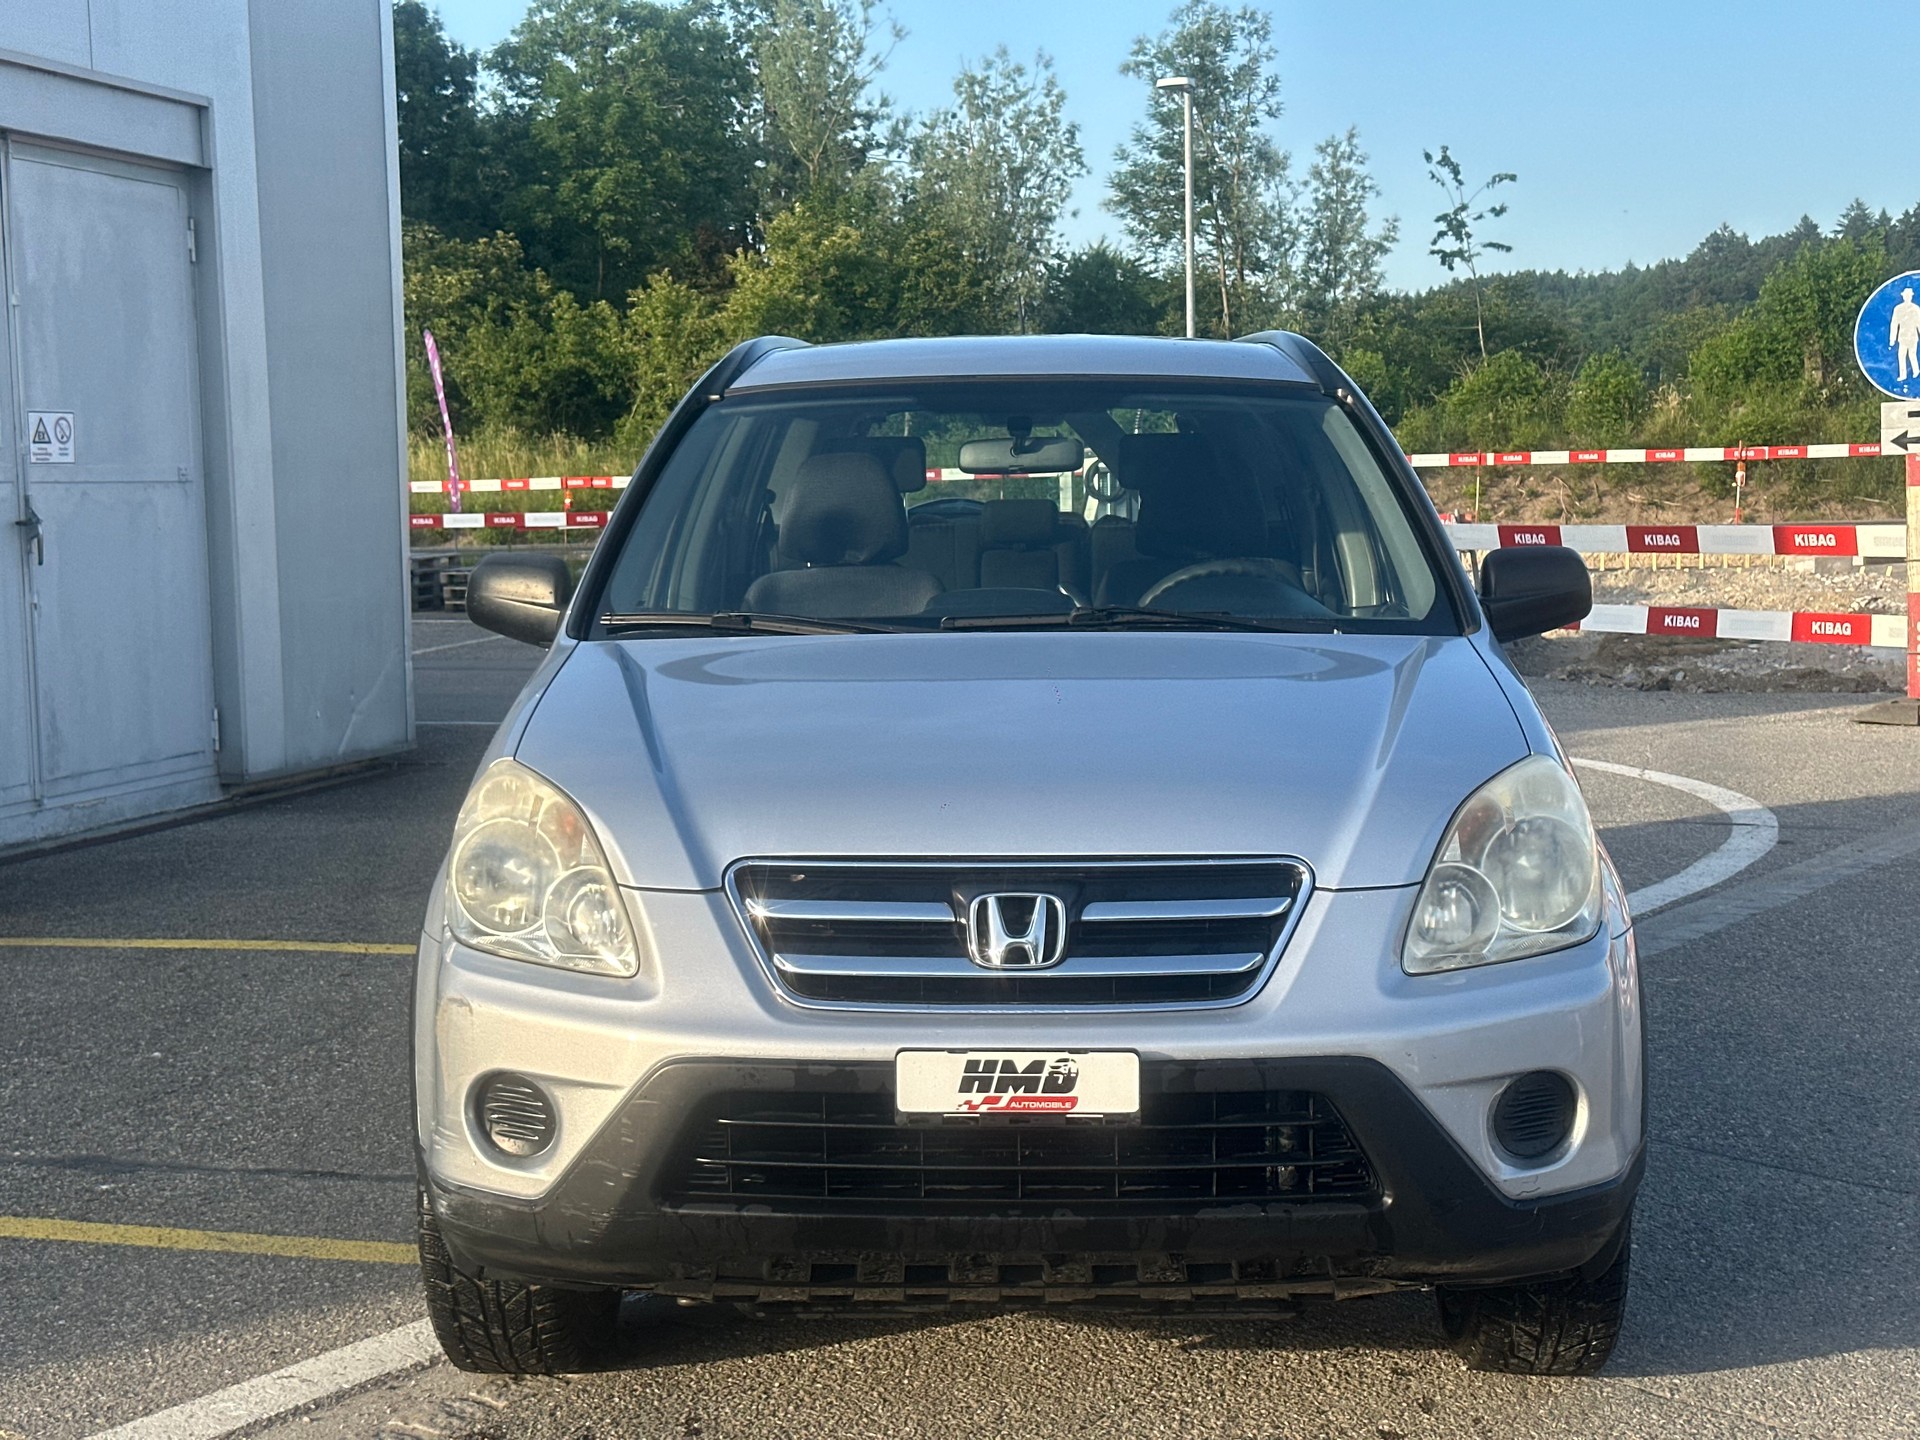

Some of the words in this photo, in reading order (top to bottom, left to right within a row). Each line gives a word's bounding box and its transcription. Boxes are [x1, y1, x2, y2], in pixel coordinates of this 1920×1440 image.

[1514, 533, 1546, 545] KIBAG
[1644, 534, 1681, 546] KIBAG
[1794, 533, 1837, 547] KIBAG
[1664, 615, 1700, 629] KIBAG
[1811, 621, 1852, 636] KIBAG
[1009, 1101, 1073, 1110] AUTOMOBILE
